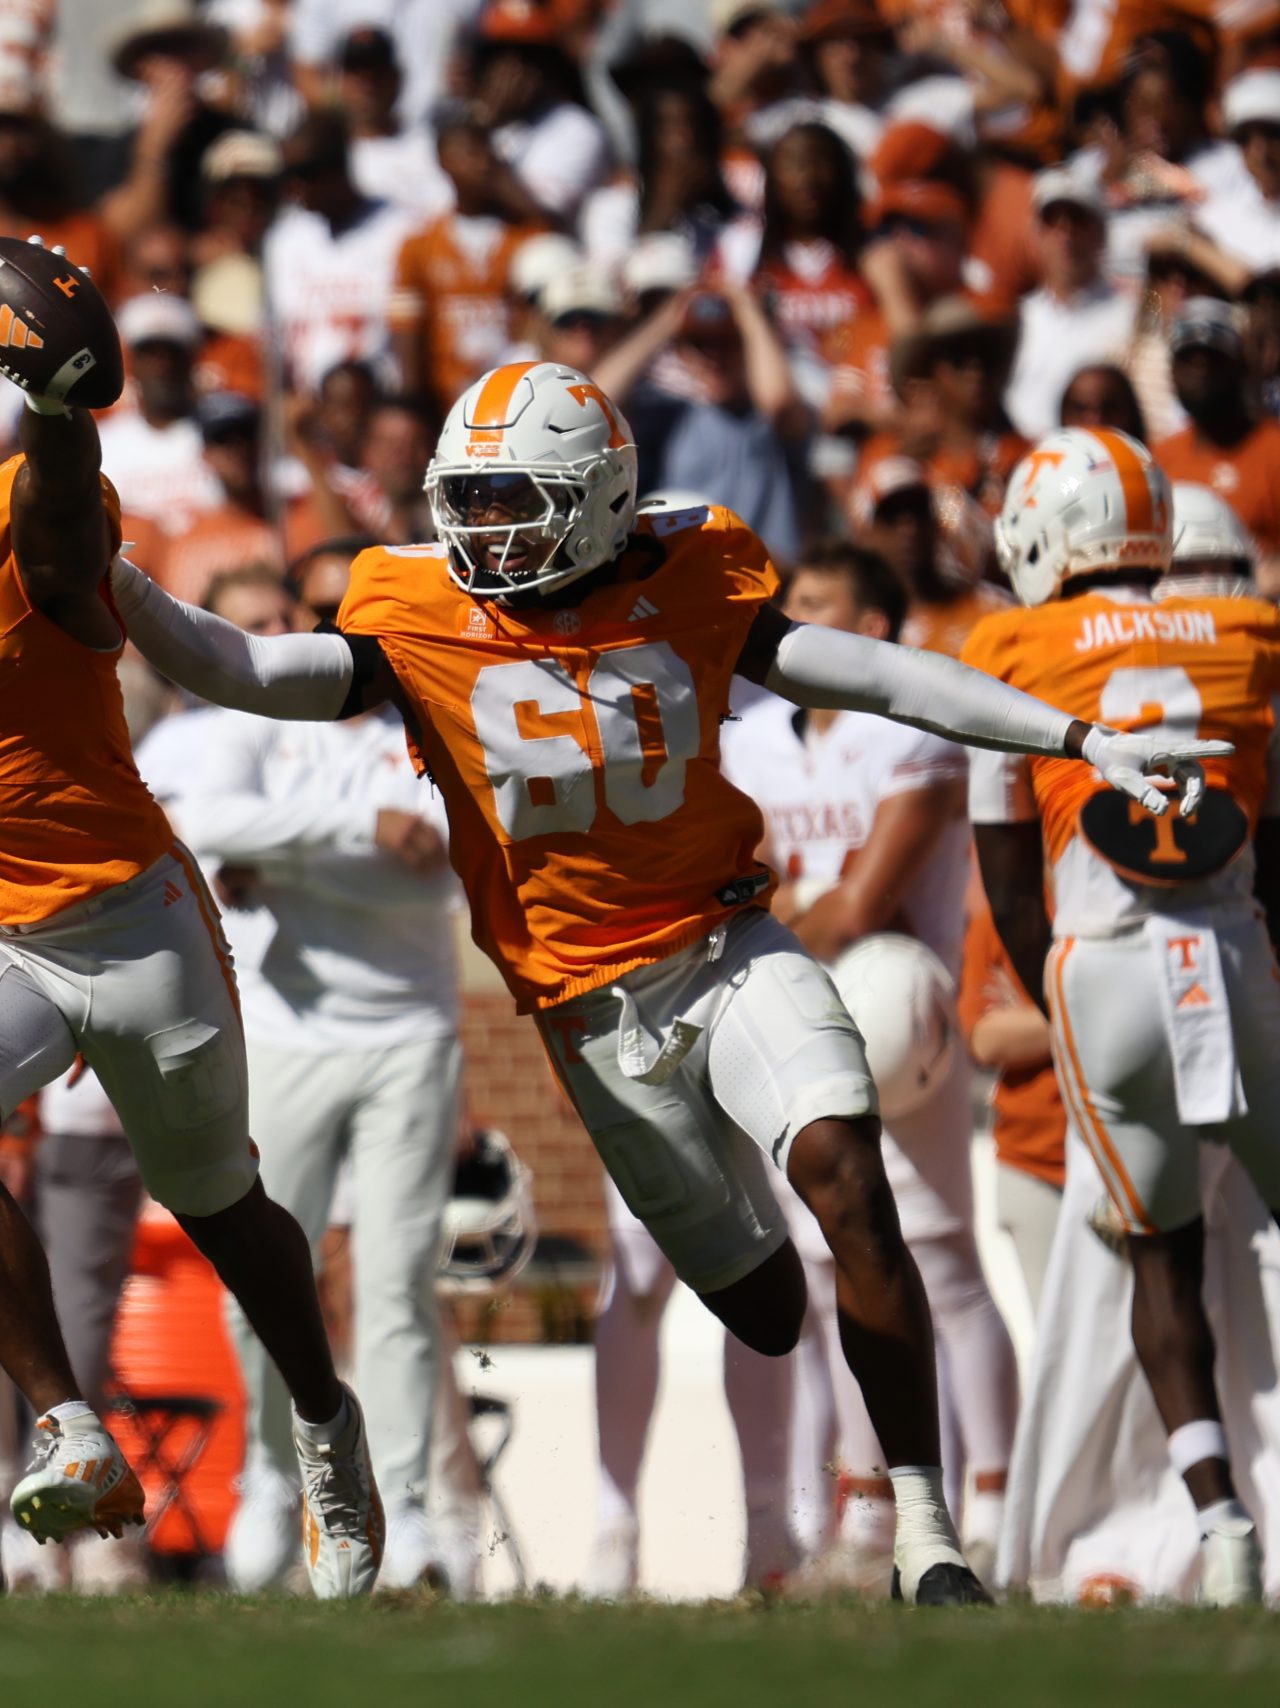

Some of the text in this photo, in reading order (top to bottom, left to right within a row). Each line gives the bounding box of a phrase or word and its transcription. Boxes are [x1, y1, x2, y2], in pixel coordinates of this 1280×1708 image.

[52, 273, 81, 299] T
[566, 384, 627, 450] T
[1023, 451, 1065, 509] T
[460, 630, 494, 640] HORIZON
[466, 625, 487, 633] FIRST
[1074, 608, 1218, 651] JACKSON
[470, 640, 701, 842] 60
[1128, 792, 1198, 864] T
[1166, 935, 1201, 970] T
